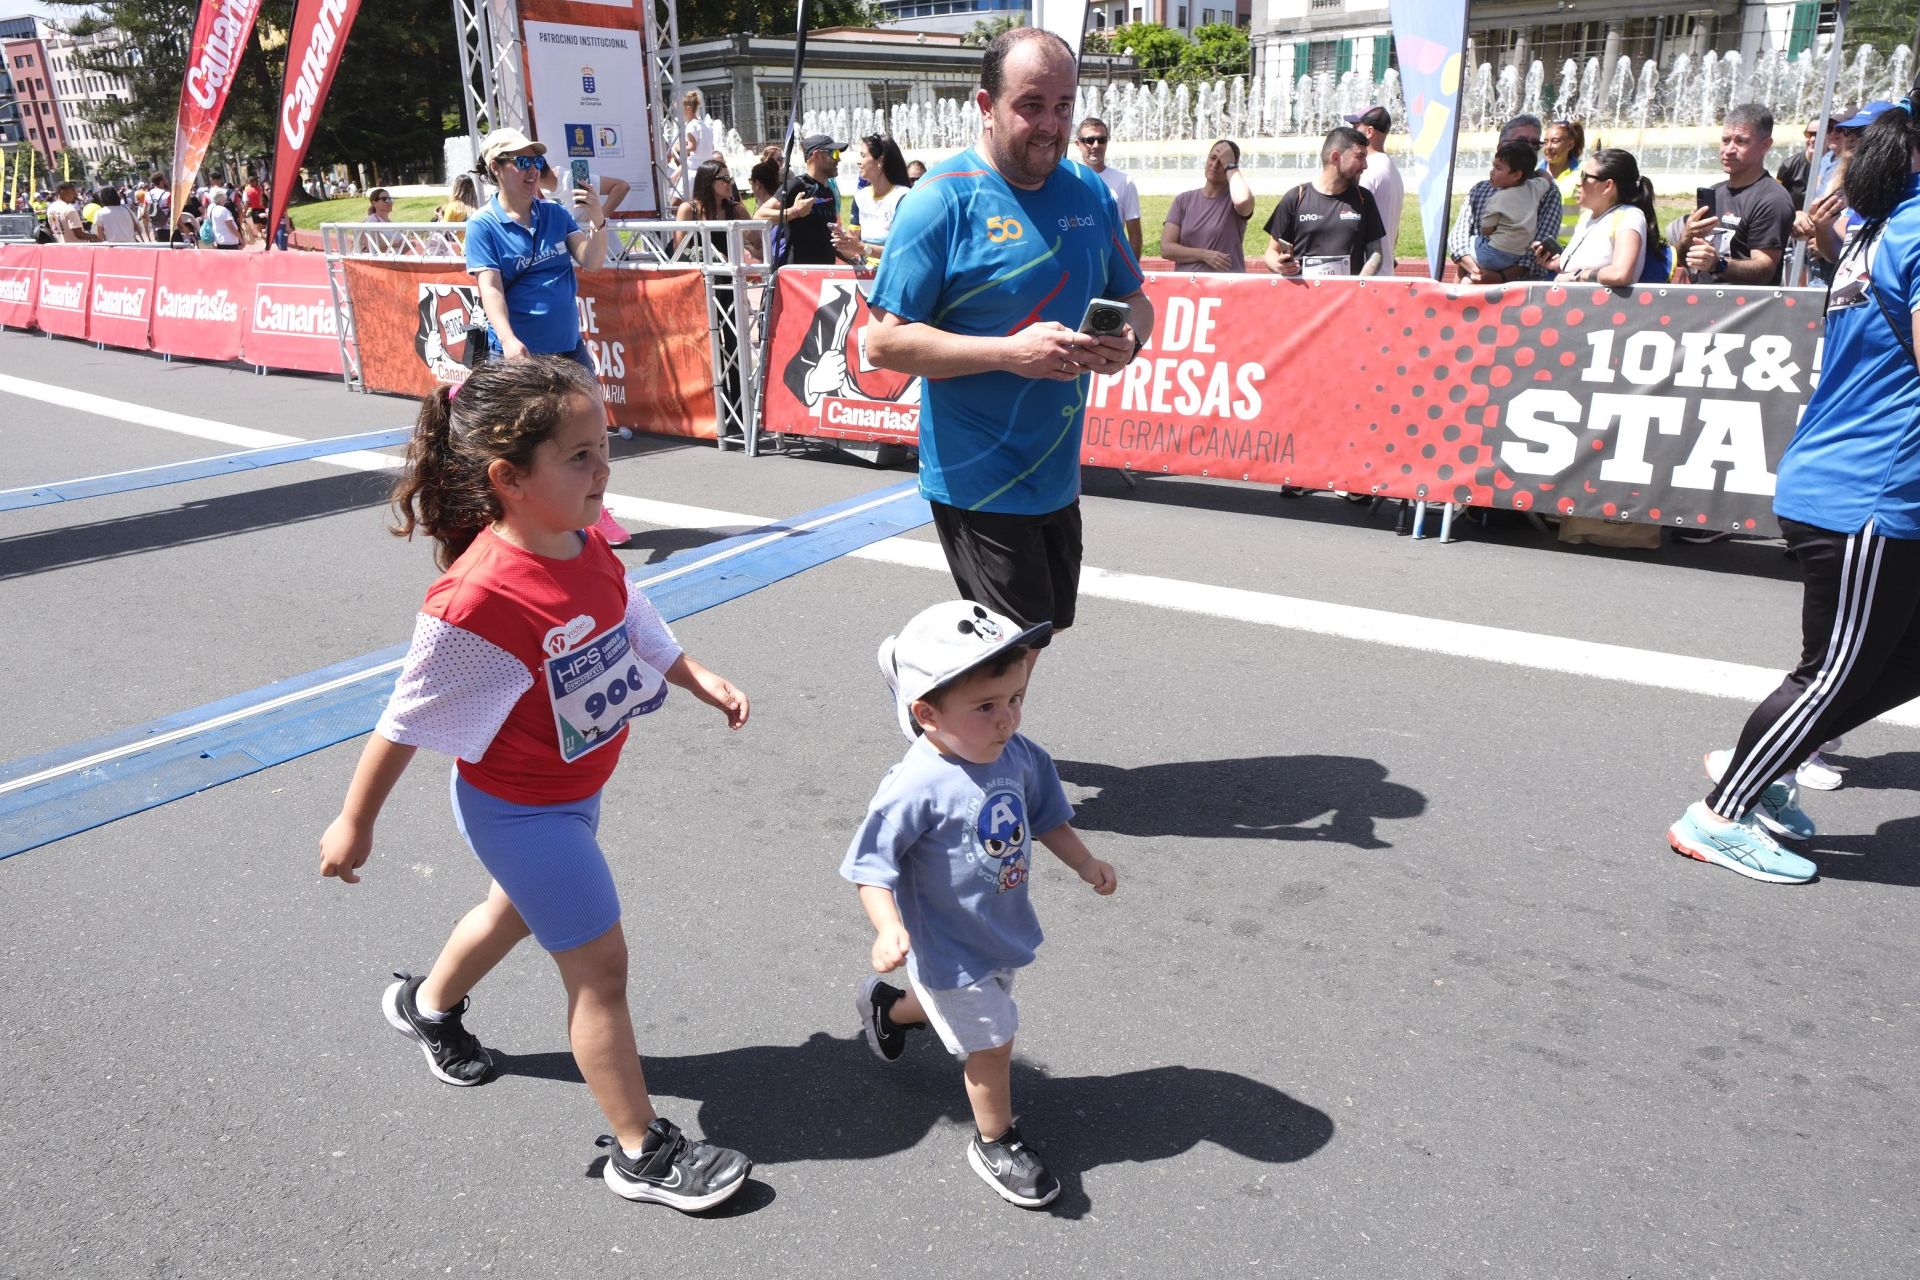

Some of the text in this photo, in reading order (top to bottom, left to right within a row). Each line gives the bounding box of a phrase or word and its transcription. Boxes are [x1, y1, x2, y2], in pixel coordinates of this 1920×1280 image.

[186, 0, 250, 110] Canari
[538, 32, 628, 50] PATROCINIO INSTITUCIONAL
[282, 0, 348, 150] Canari
[986, 215, 1023, 243] 50
[1058, 214, 1096, 231] global
[41, 278, 83, 309] Canarias7
[93, 283, 146, 317] Canarias7
[576, 296, 600, 334] DE
[1161, 296, 1222, 354] DE
[1085, 357, 1266, 421] PRESAS
[827, 401, 920, 432] Canarias7
[1086, 416, 1295, 465] DE GRAN CANARIA
[1500, 388, 1807, 497] STA
[556, 647, 601, 684] HPS
